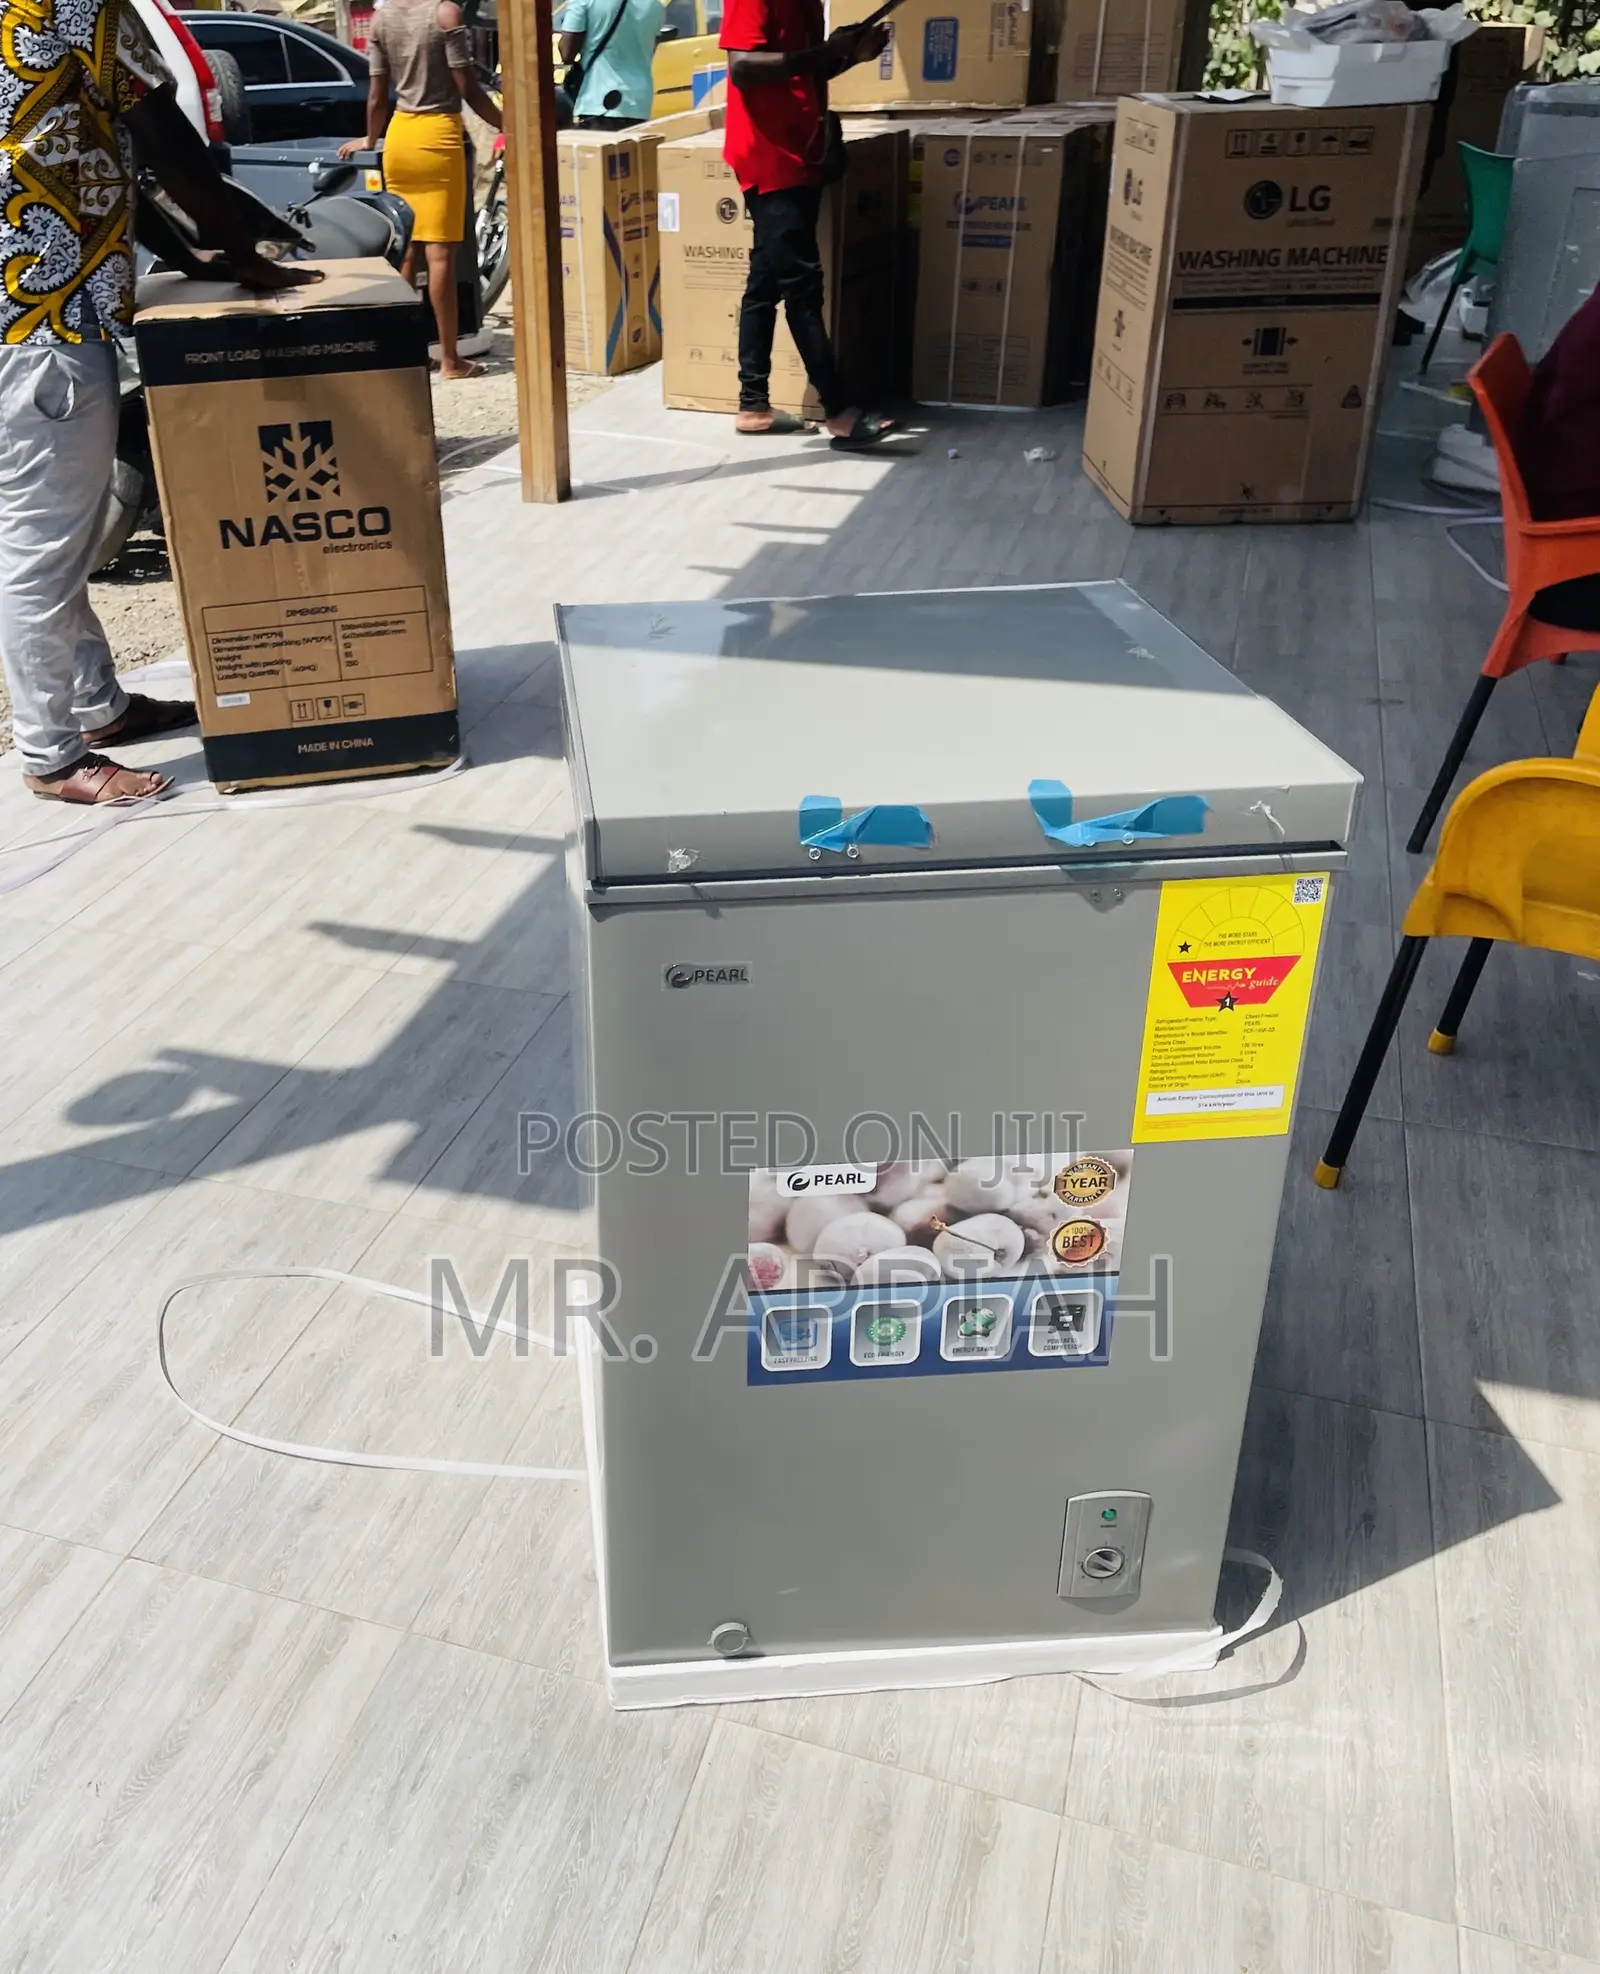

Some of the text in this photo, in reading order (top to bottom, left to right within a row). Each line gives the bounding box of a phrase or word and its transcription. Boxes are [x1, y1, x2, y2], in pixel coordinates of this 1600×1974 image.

[1289, 185, 1332, 212] LG
[683, 245, 744, 259] WASHING
[1179, 245, 1391, 270] WASHING MACHINE
[184, 340, 378, 364] FRONT LOAD WASHING MACHINE
[219, 506, 392, 549] NASCO
[323, 540, 392, 554] electronics
[286, 605, 339, 618] DIMENSIONS
[298, 737, 374, 754] MADE IN CHINA
[694, 967, 749, 982] PEARL
[1182, 966, 1279, 990] ENERGY guide
[1224, 997, 1231, 1007] 1
[1067, 1163, 1105, 1175] WARRANTY
[814, 1173, 866, 1186] PEARL
[1061, 1176, 1108, 1189] 1 YEAR
[1064, 1190, 1103, 1203] WARRANTY
[1071, 1227, 1090, 1235] 100%
[1062, 1234, 1096, 1249] BEST
